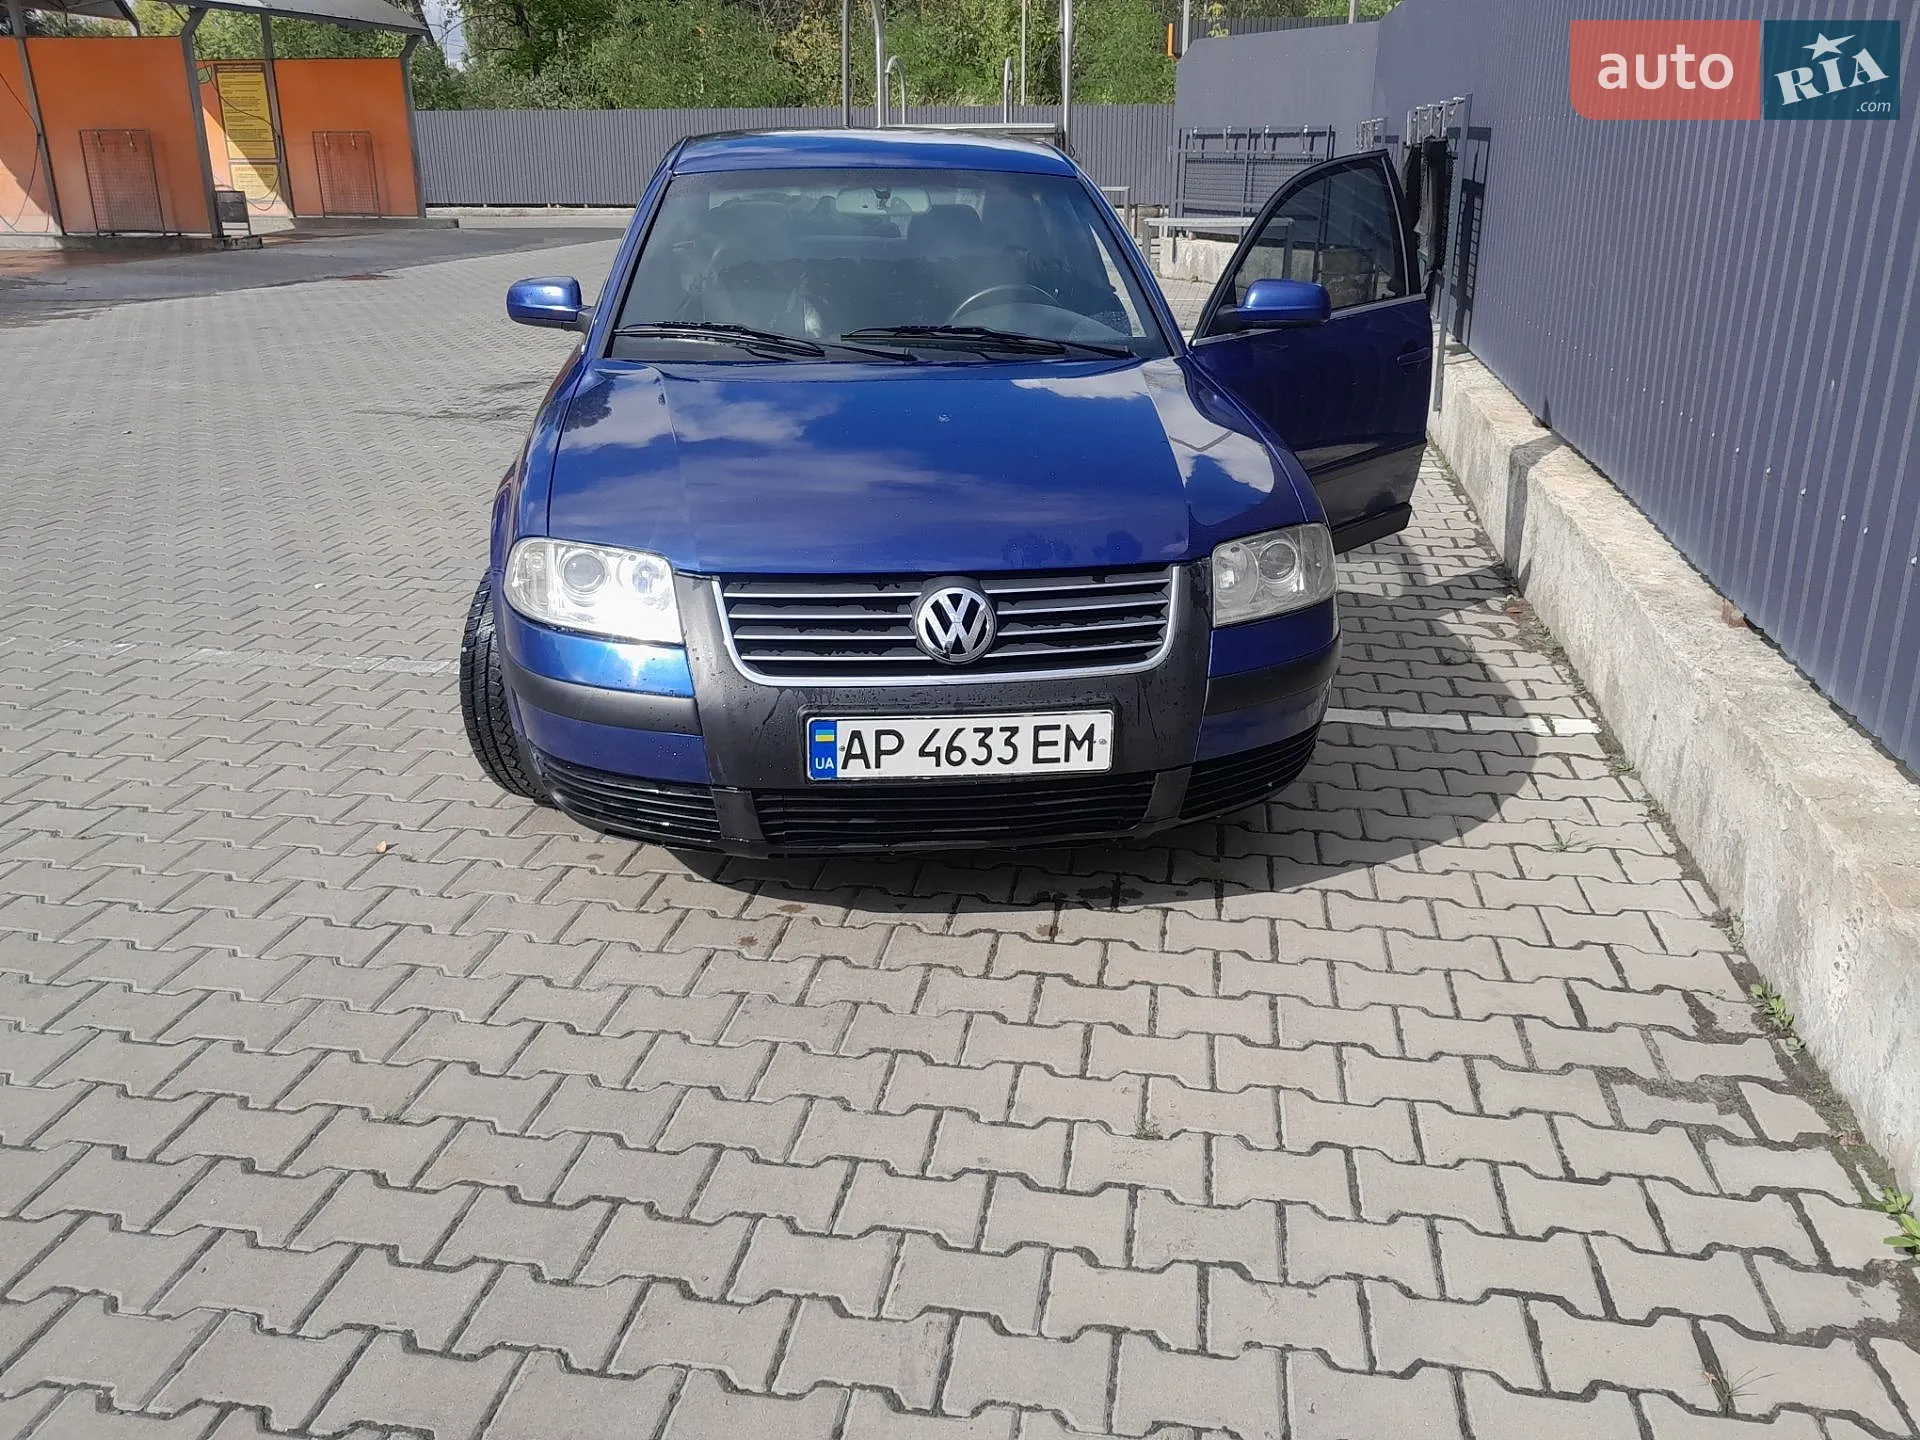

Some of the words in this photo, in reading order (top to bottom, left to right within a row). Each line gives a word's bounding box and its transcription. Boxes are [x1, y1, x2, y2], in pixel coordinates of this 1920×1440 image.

[841, 730, 905, 769] AP
[918, 727, 1020, 767] 4633
[1032, 723, 1094, 764] EM
[815, 756, 835, 770] UA
